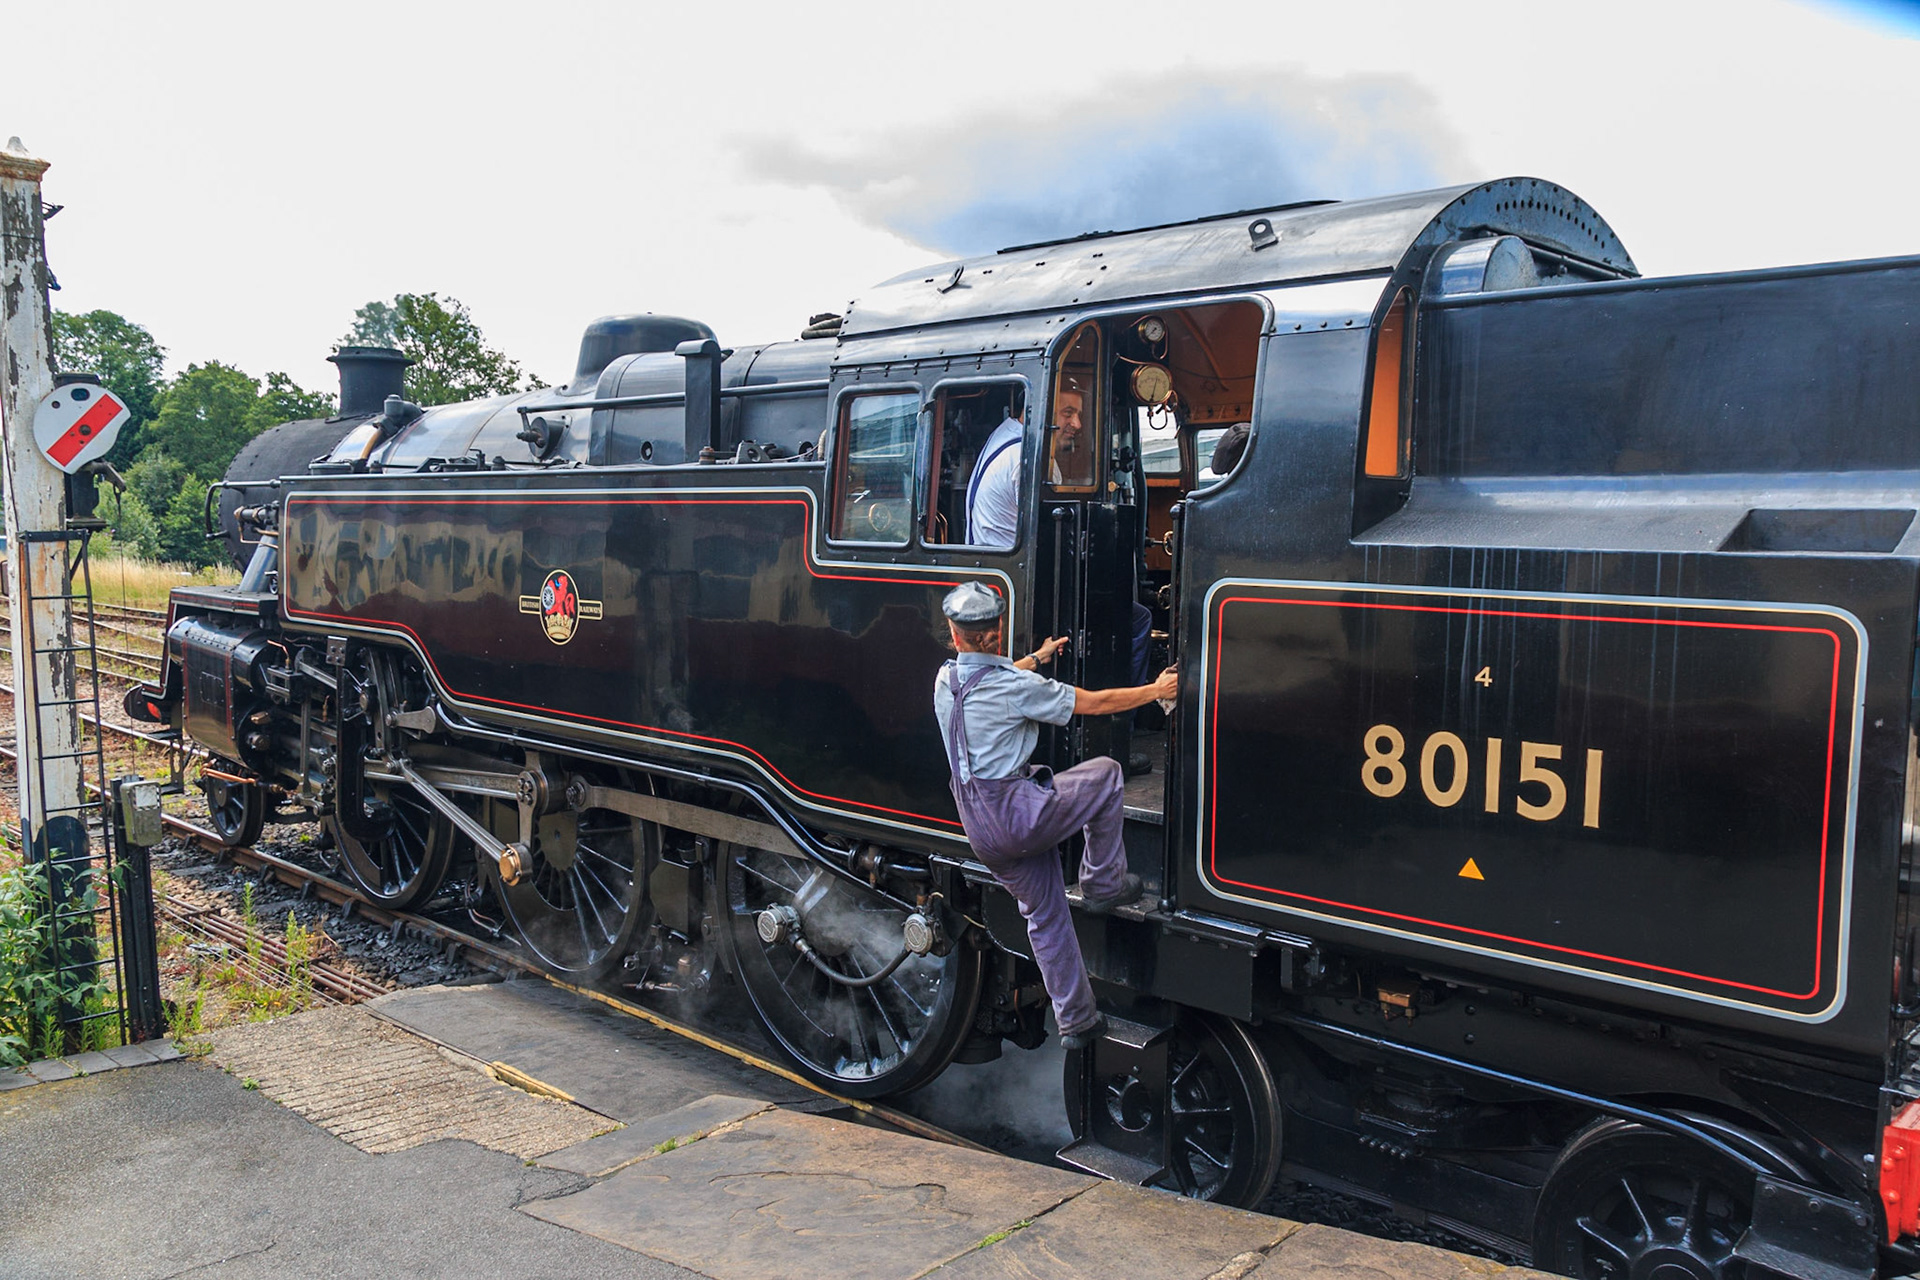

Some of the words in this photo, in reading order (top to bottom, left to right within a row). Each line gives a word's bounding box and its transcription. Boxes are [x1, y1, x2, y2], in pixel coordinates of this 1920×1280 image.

[579, 605, 601, 614] RAILWAYS
[1474, 666, 1493, 687] 4
[1361, 724, 1603, 828] 80151
